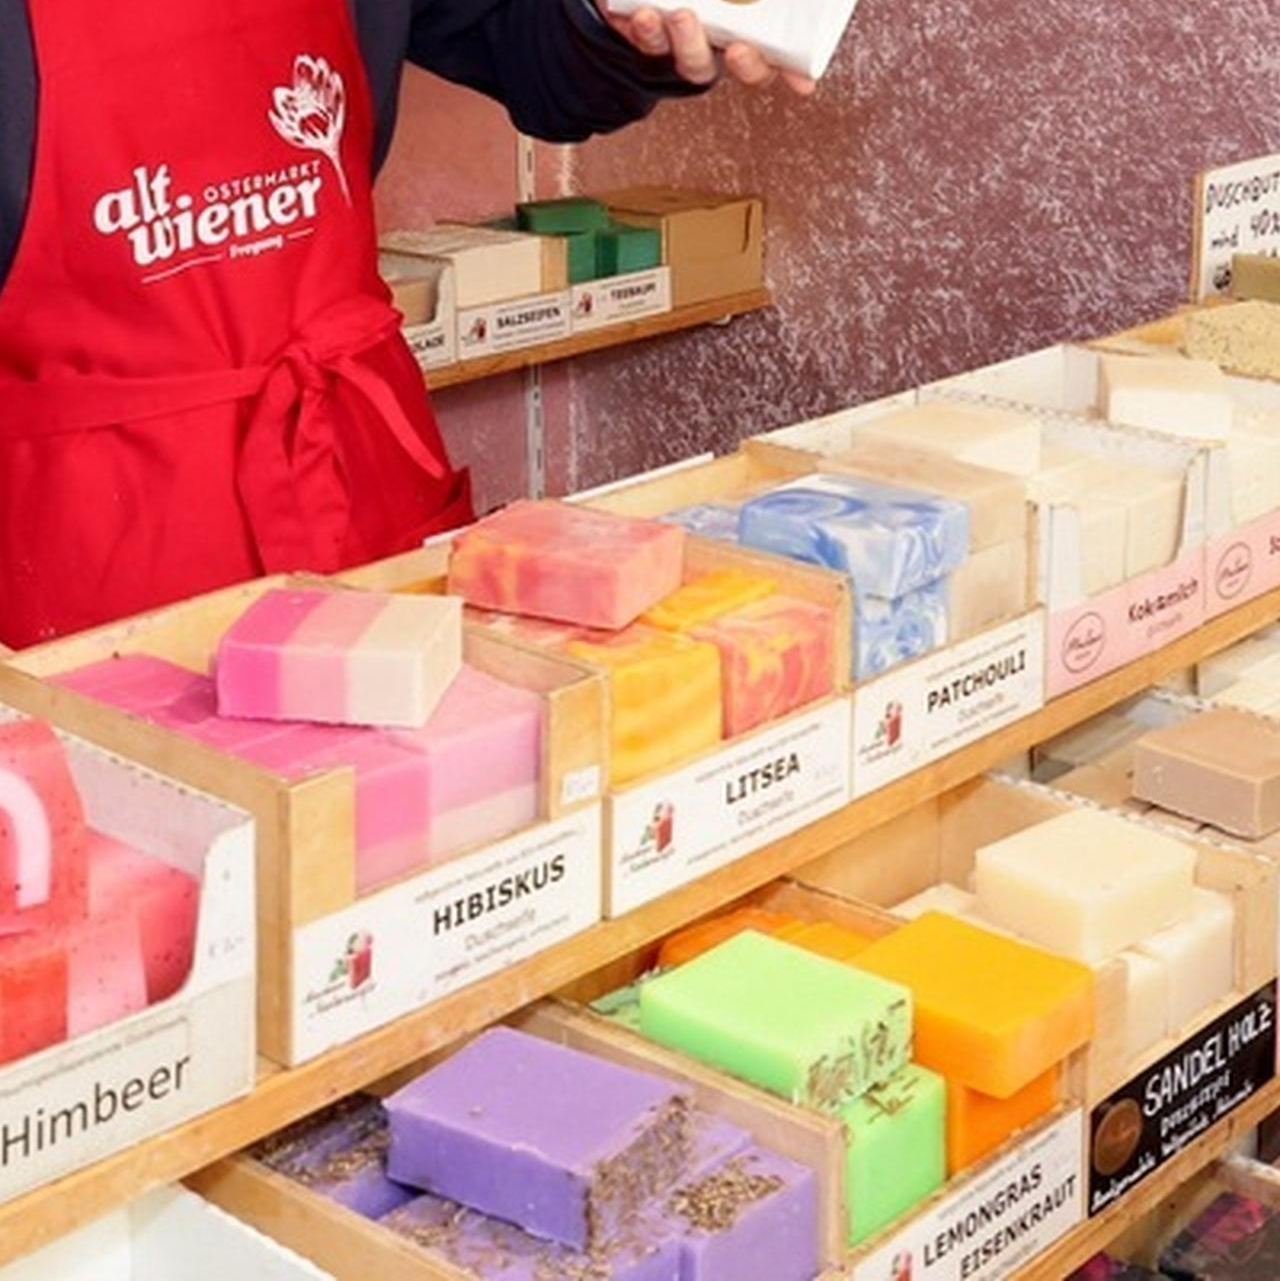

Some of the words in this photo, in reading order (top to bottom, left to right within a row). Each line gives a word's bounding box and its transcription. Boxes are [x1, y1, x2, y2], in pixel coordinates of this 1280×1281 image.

[92, 164, 172, 235] alt
[128, 176, 322, 266] wiener
[204, 159, 322, 203] OSTERMARKT
[927, 649, 1027, 714] PATCHOULI
[725, 752, 801, 805] LITSEA
[432, 853, 566, 936] HIBISKUS
[1143, 1031, 1227, 1117] SANDEL
[1227, 1003, 1273, 1058] HOLZ
[0, 1055, 191, 1167] Himbeer
[923, 1162, 1043, 1268] LEMONGRAS
[960, 1173, 1077, 1280] EISENKRAUT
